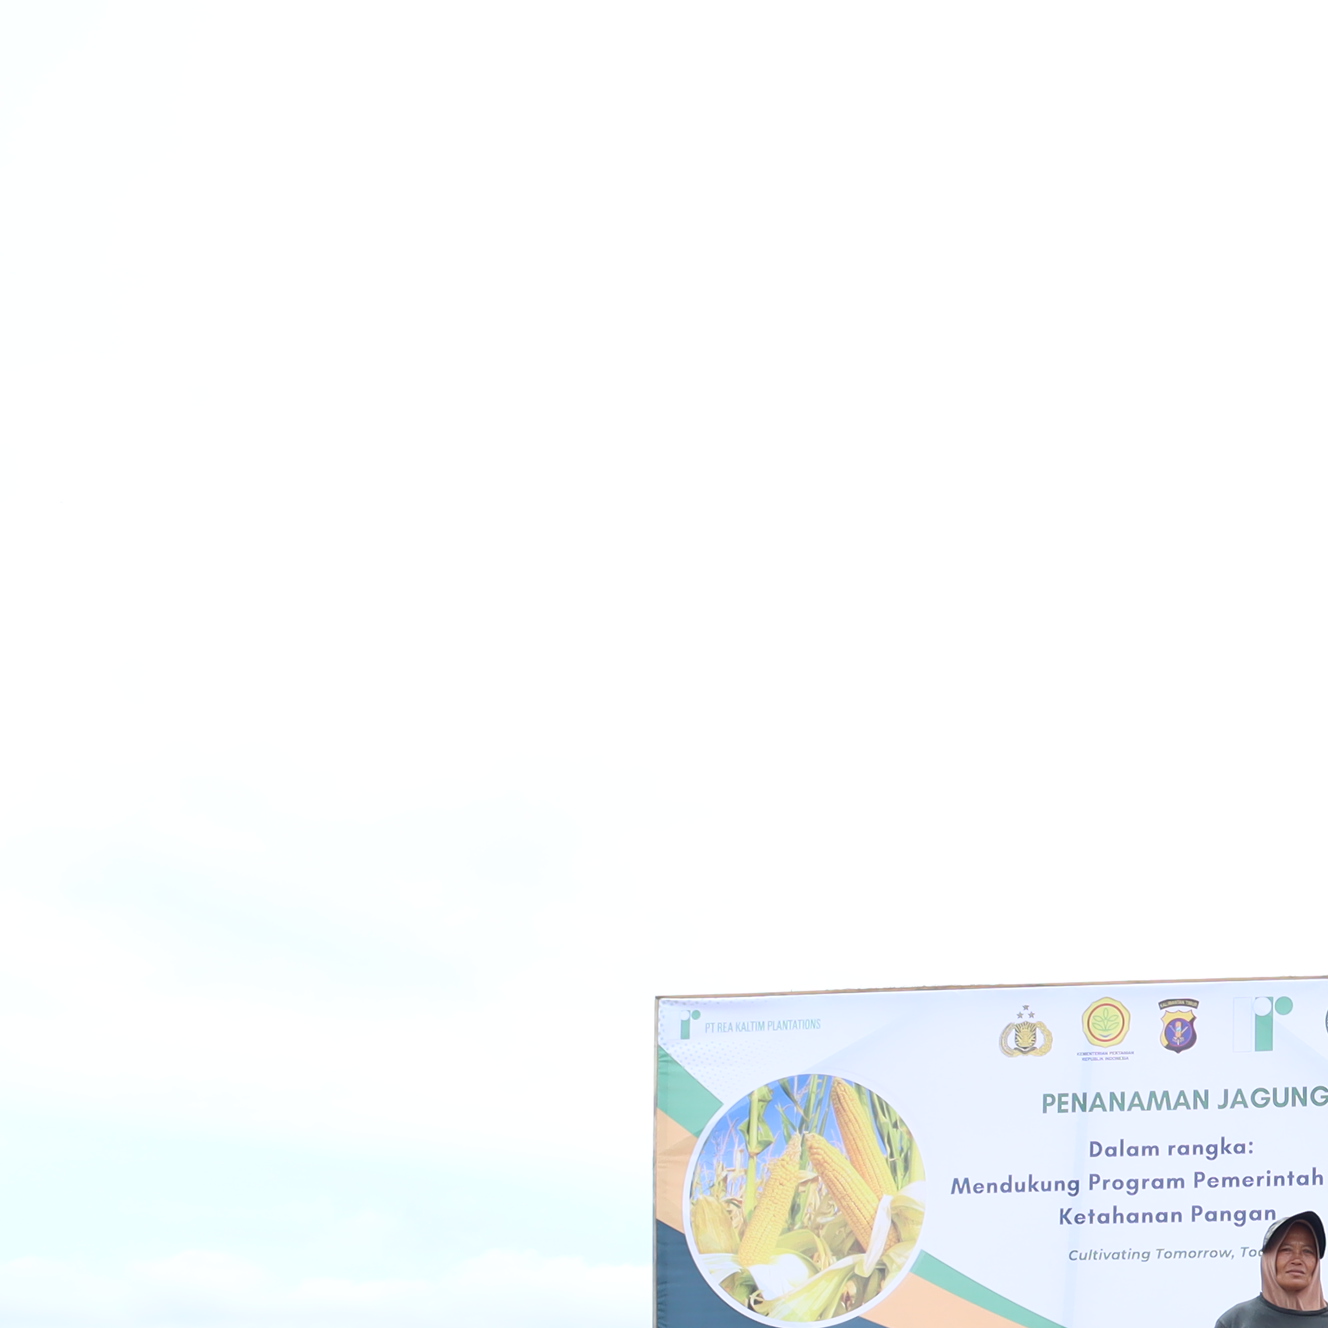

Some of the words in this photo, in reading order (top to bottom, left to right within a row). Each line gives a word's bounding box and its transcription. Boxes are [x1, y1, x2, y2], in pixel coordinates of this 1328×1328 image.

[705, 1023, 715, 1033] PT
[717, 1022, 733, 1033] REA
[735, 1020, 765, 1032] KALTIM
[767, 1018, 821, 1031] PLANTATIONS
[1042, 1088, 1210, 1114] PENANAMAN
[1089, 1139, 1160, 1158] Dalam
[1168, 1136, 1255, 1161] rangka:
[950, 1174, 1081, 1197] Mendukung
[1088, 1173, 1186, 1196] Program
[1193, 1167, 1324, 1189] Pemerintah
[1058, 1205, 1183, 1226] Ketahanan
[1191, 1205, 1277, 1227] Pangan
[1068, 1246, 1151, 1263] Cultivating
[1156, 1245, 1235, 1262] Tomorrow,
